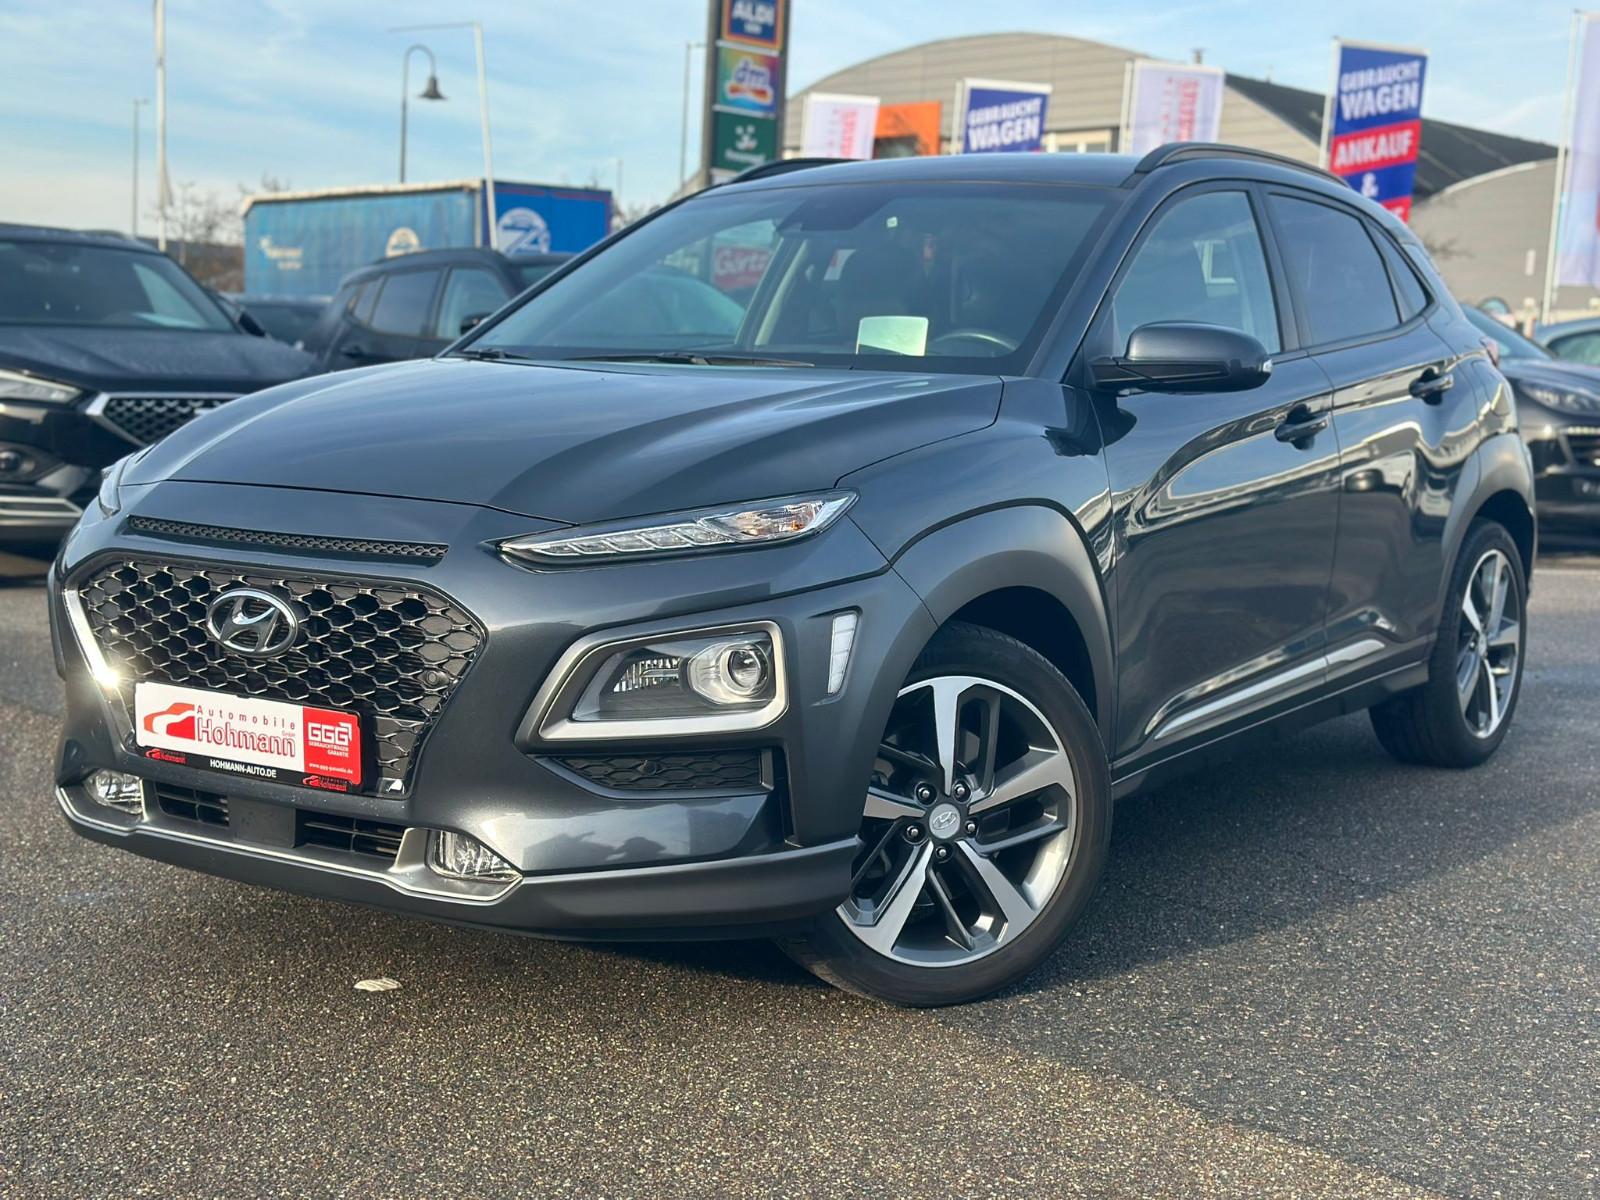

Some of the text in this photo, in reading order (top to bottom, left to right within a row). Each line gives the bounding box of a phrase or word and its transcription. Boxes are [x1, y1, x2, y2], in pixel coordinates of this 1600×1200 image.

[1340, 60, 1421, 92] GEBRAUCHT
[1340, 81, 1420, 121] WAGEN
[968, 115, 1040, 151] WAGEN
[1334, 130, 1413, 168] ANKAUF
[1361, 172, 1378, 198] &
[197, 705, 295, 730] Automobile
[197, 717, 295, 758] Hohmann
[308, 722, 350, 746] GGG
[209, 758, 277, 778] HOHMANN-AUTO.DE
